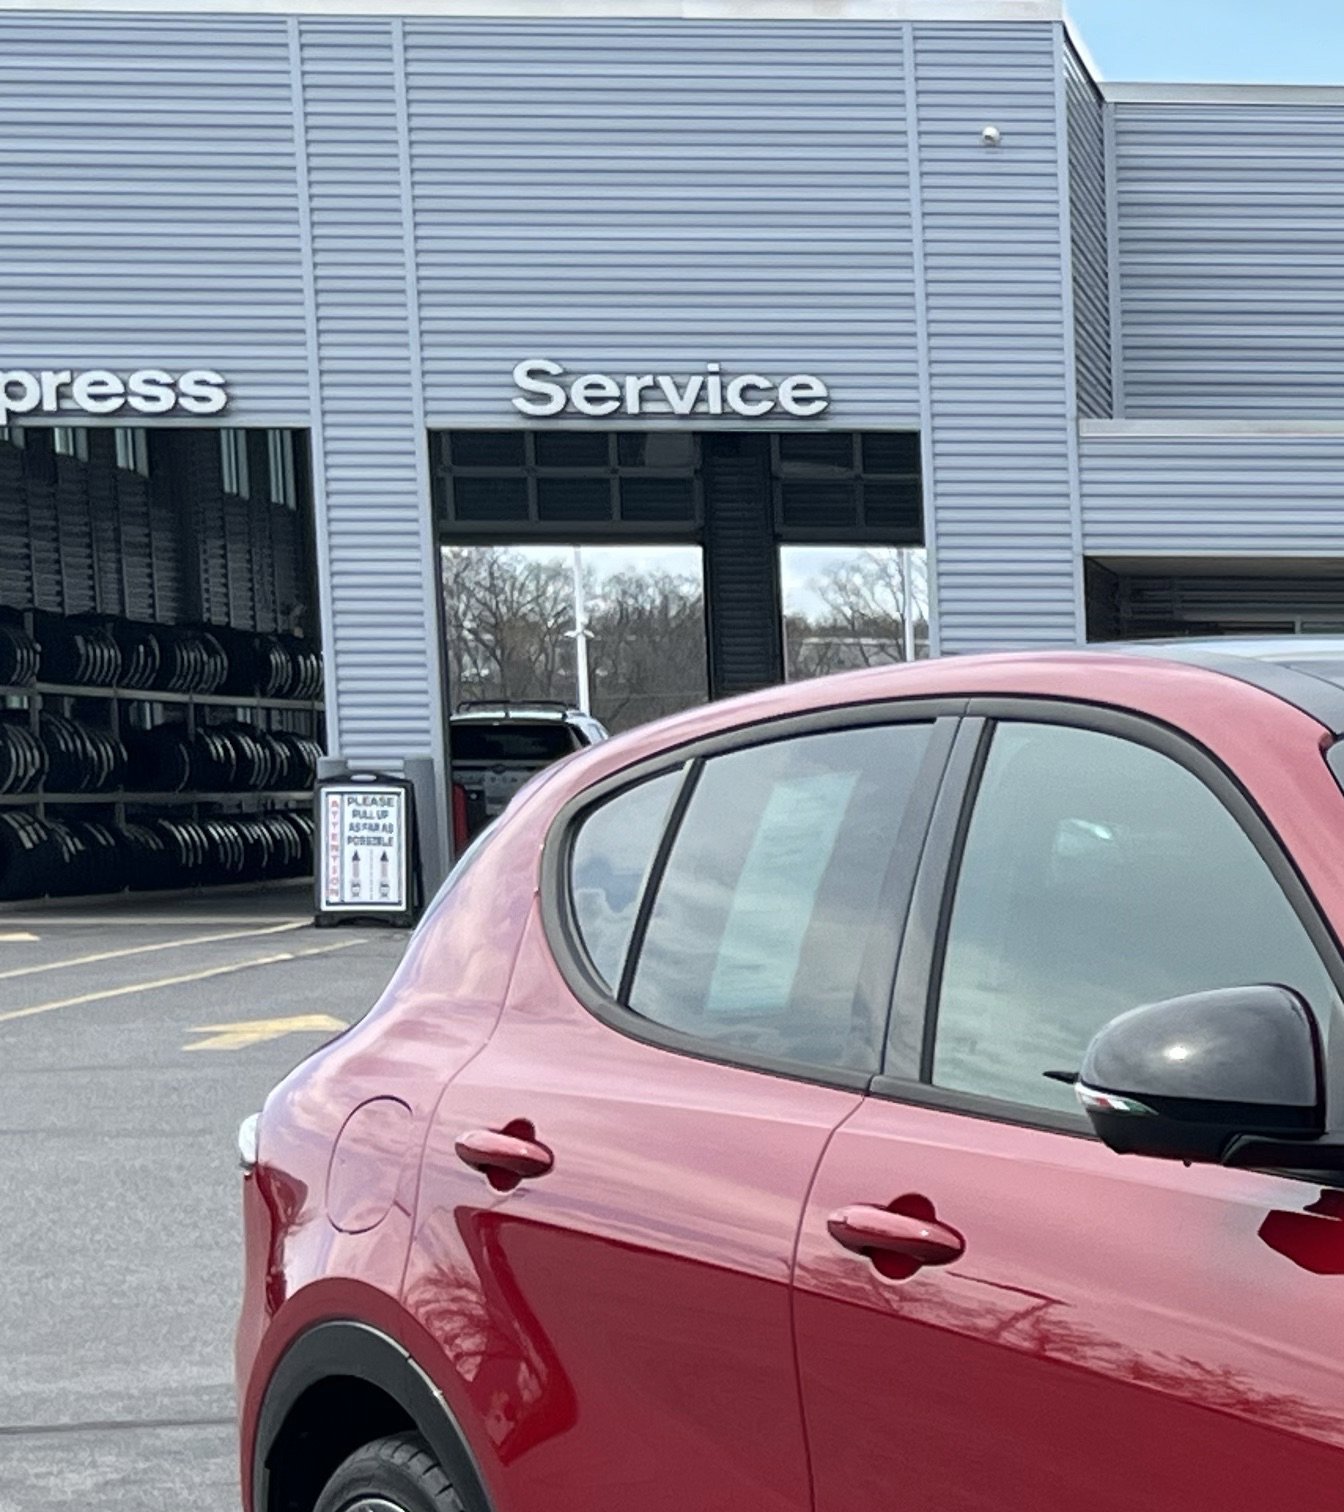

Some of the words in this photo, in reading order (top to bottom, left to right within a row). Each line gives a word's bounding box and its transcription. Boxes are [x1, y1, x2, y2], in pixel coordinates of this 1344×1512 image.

[0, 369, 227, 426] press
[511, 359, 830, 416] Service
[347, 797, 394, 807] PLEASE
